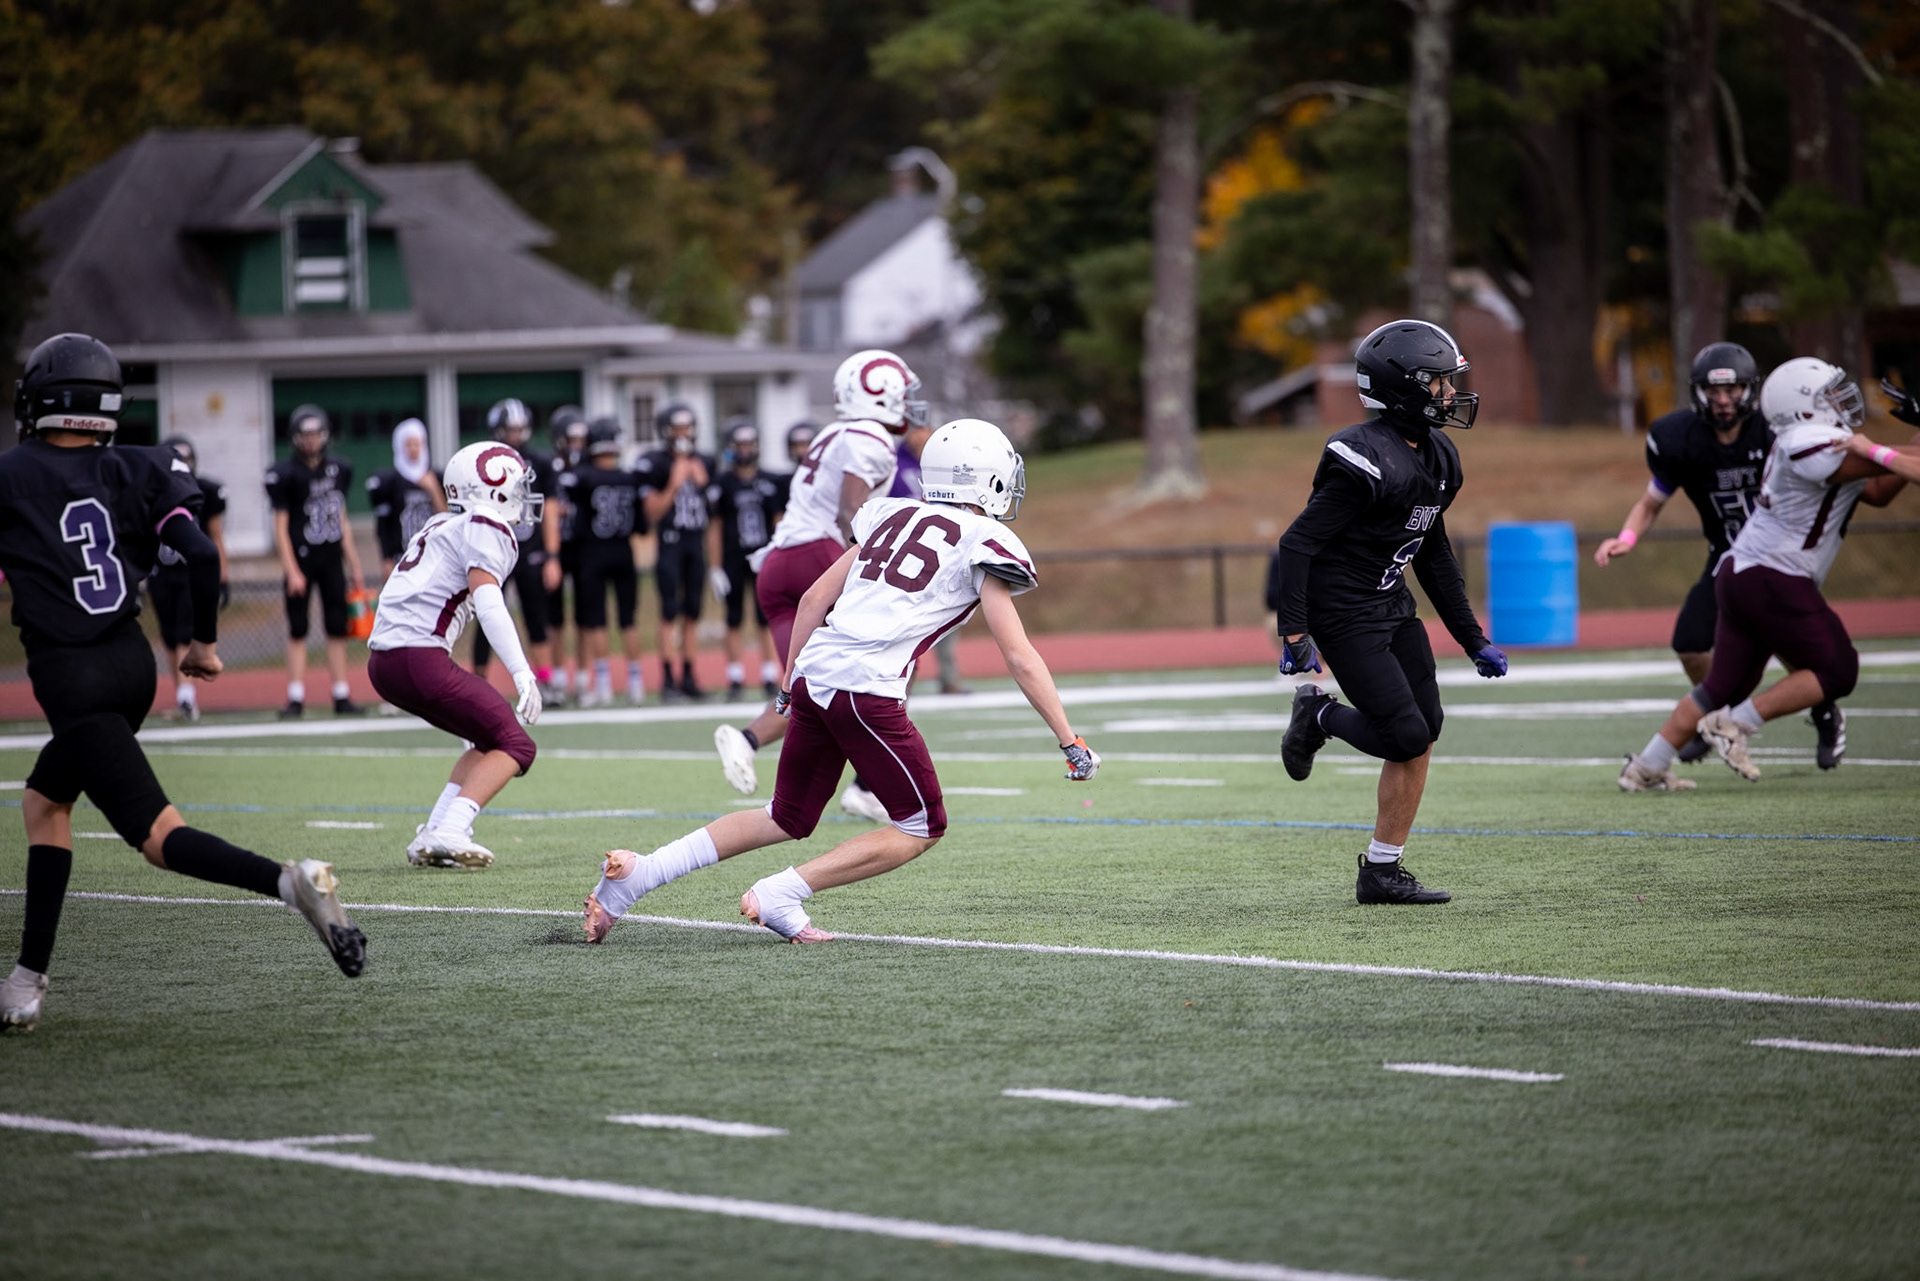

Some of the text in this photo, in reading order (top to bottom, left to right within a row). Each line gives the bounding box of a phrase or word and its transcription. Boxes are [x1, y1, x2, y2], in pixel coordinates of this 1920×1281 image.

[801, 429, 841, 485] 4
[1716, 467, 1758, 491] BVT
[1404, 505, 1441, 532] BVT
[59, 497, 128, 615] 3
[858, 506, 962, 593] 46
